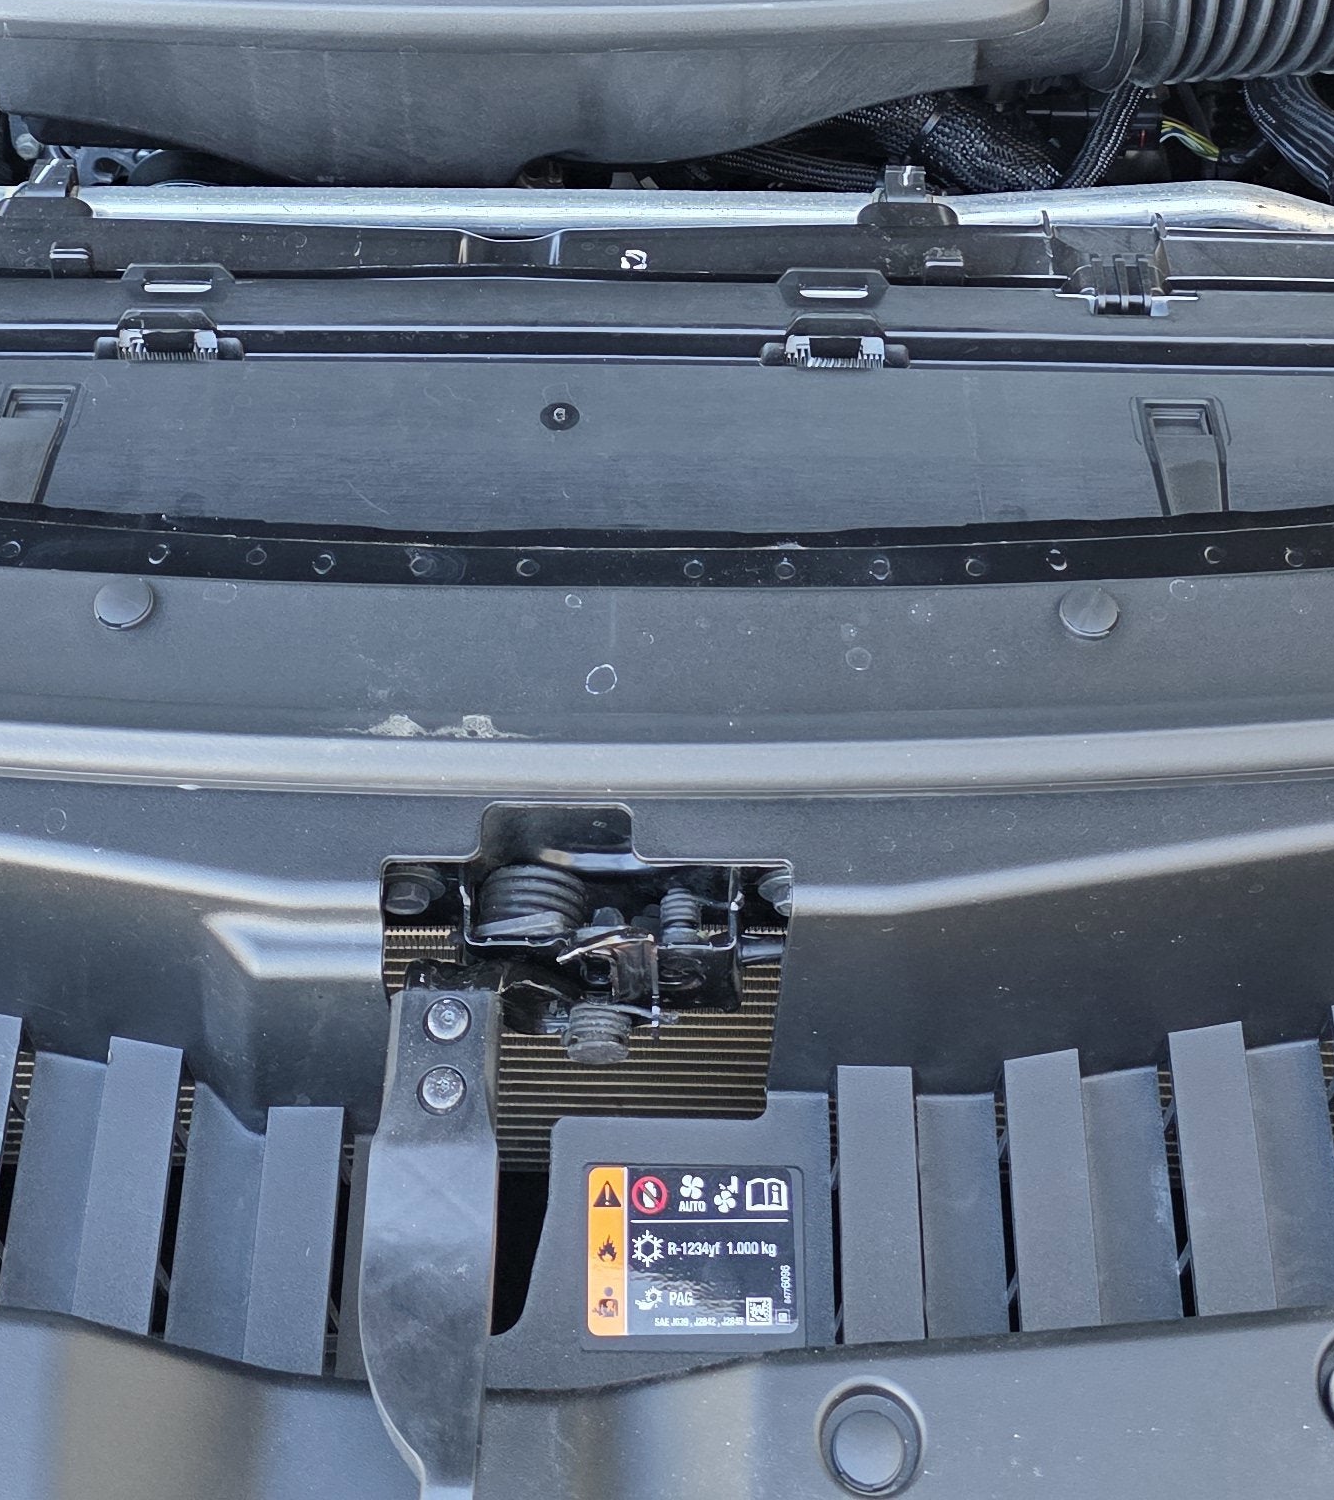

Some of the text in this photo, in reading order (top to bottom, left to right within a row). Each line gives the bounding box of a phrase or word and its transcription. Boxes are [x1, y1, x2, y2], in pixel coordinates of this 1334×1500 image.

[678, 1201, 706, 1212] AUTO
[668, 1241, 777, 1257] R-1234yf 1.000 kg
[669, 1292, 693, 1305] PAG
